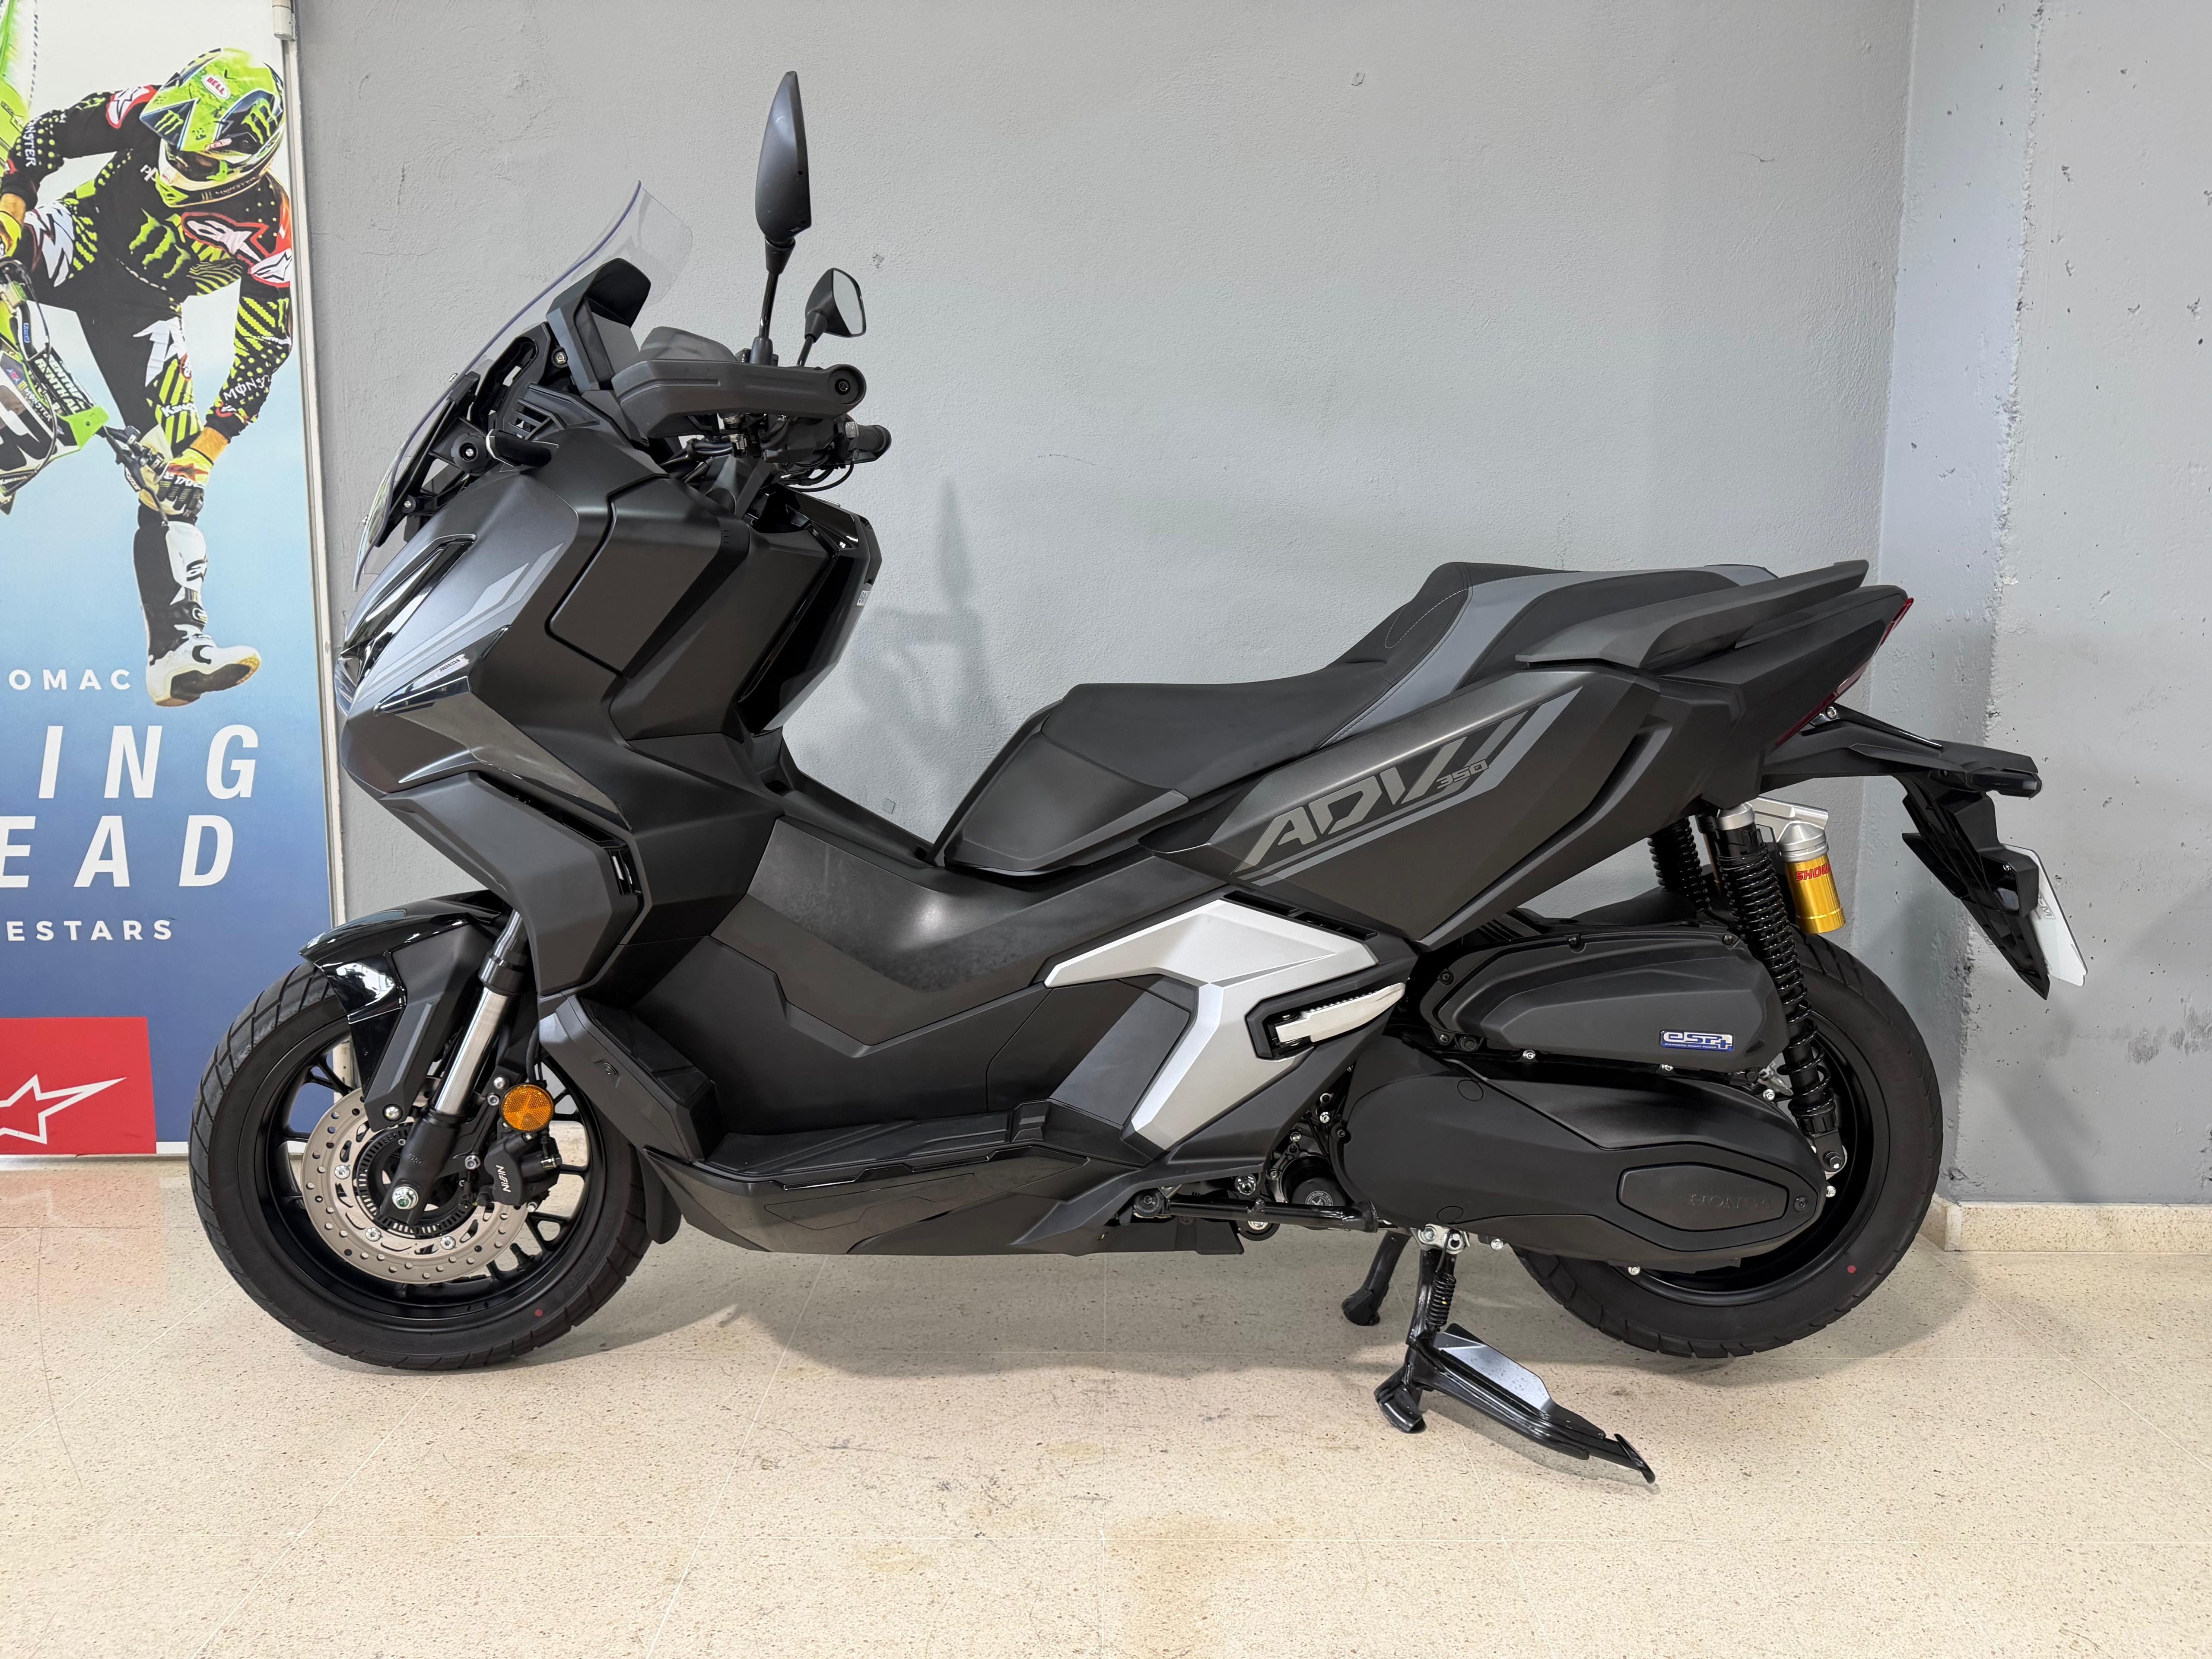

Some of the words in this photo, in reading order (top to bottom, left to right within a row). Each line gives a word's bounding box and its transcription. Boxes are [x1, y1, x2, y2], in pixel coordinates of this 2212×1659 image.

[207, 77, 226, 95] BELL
[439, 659, 461, 672] HONDA
[8, 669, 131, 691] OMAC
[38, 724, 259, 799] ING
[1234, 735, 1467, 873] ADV
[1436, 759, 1489, 790] 350
[0, 815, 234, 888] EAD
[6, 919, 172, 941] ESTARS
